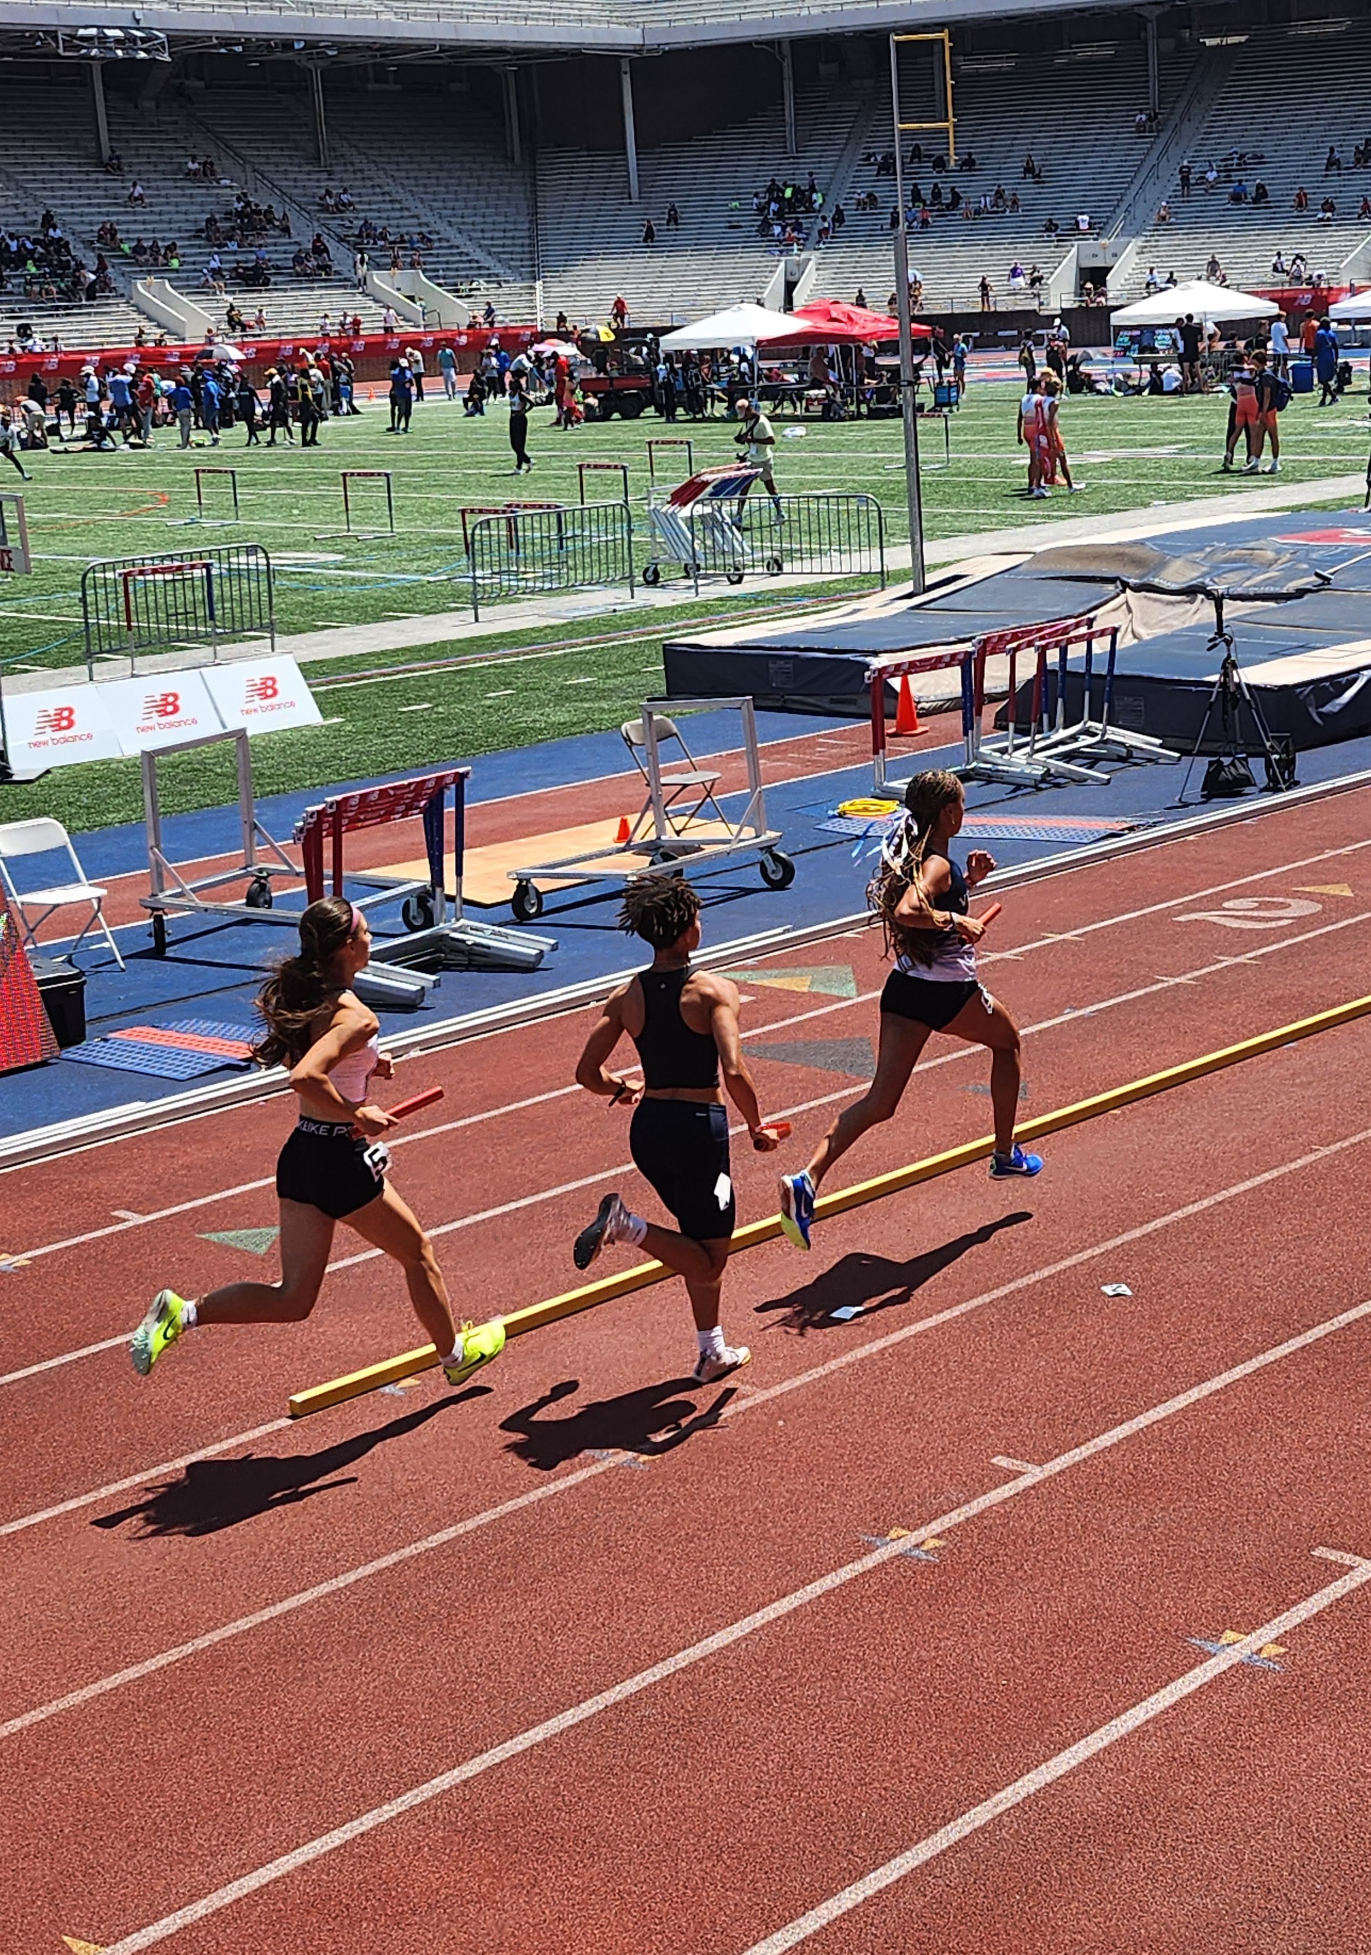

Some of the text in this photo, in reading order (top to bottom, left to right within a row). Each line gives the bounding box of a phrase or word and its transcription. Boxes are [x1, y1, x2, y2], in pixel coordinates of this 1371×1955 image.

[239, 700, 296, 716] new balance
[136, 717, 198, 734] new balance
[27, 732, 93, 749] new balance
